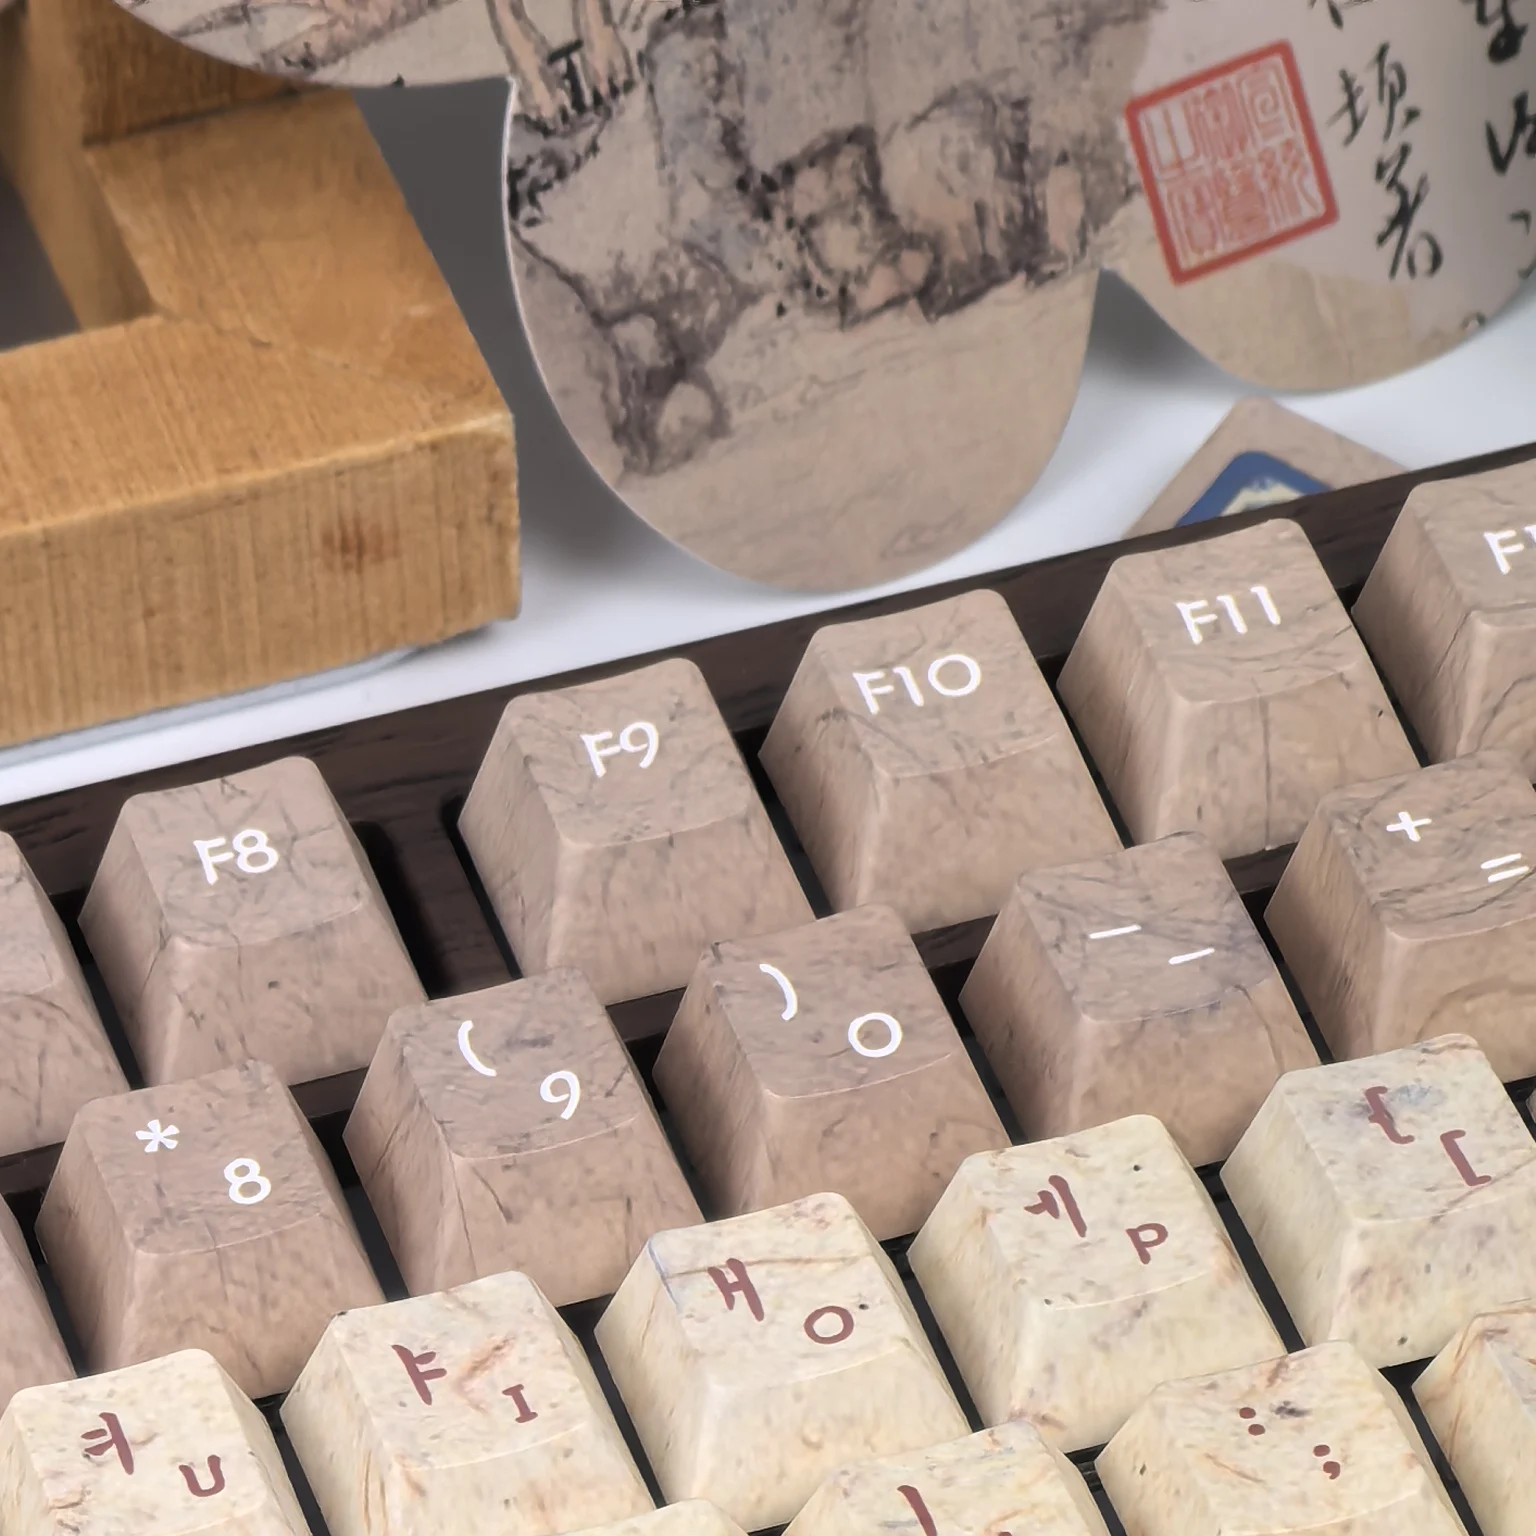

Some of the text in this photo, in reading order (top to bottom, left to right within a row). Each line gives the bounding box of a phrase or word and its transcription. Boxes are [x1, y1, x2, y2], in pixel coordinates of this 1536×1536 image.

[1174, 584, 1282, 646] F11
[851, 652, 982, 716] F10
[578, 720, 660, 779] F9
[1385, 810, 1433, 843] +
[191, 827, 280, 886] F8
[1479, 851, 1530, 884] =
[758, 962, 799, 1022] )
[456, 1019, 498, 1078] (
[538, 1069, 581, 1121] 9
[222, 1156, 273, 1206] 8
[1439, 1129, 1491, 1188] [
[1124, 1222, 1167, 1265] P
[802, 1305, 854, 1346] O
[501, 1382, 537, 1425] I
[1238, 1407, 1263, 1437] :
[177, 1454, 226, 1498] U
[1312, 1444, 1341, 1481] ;
